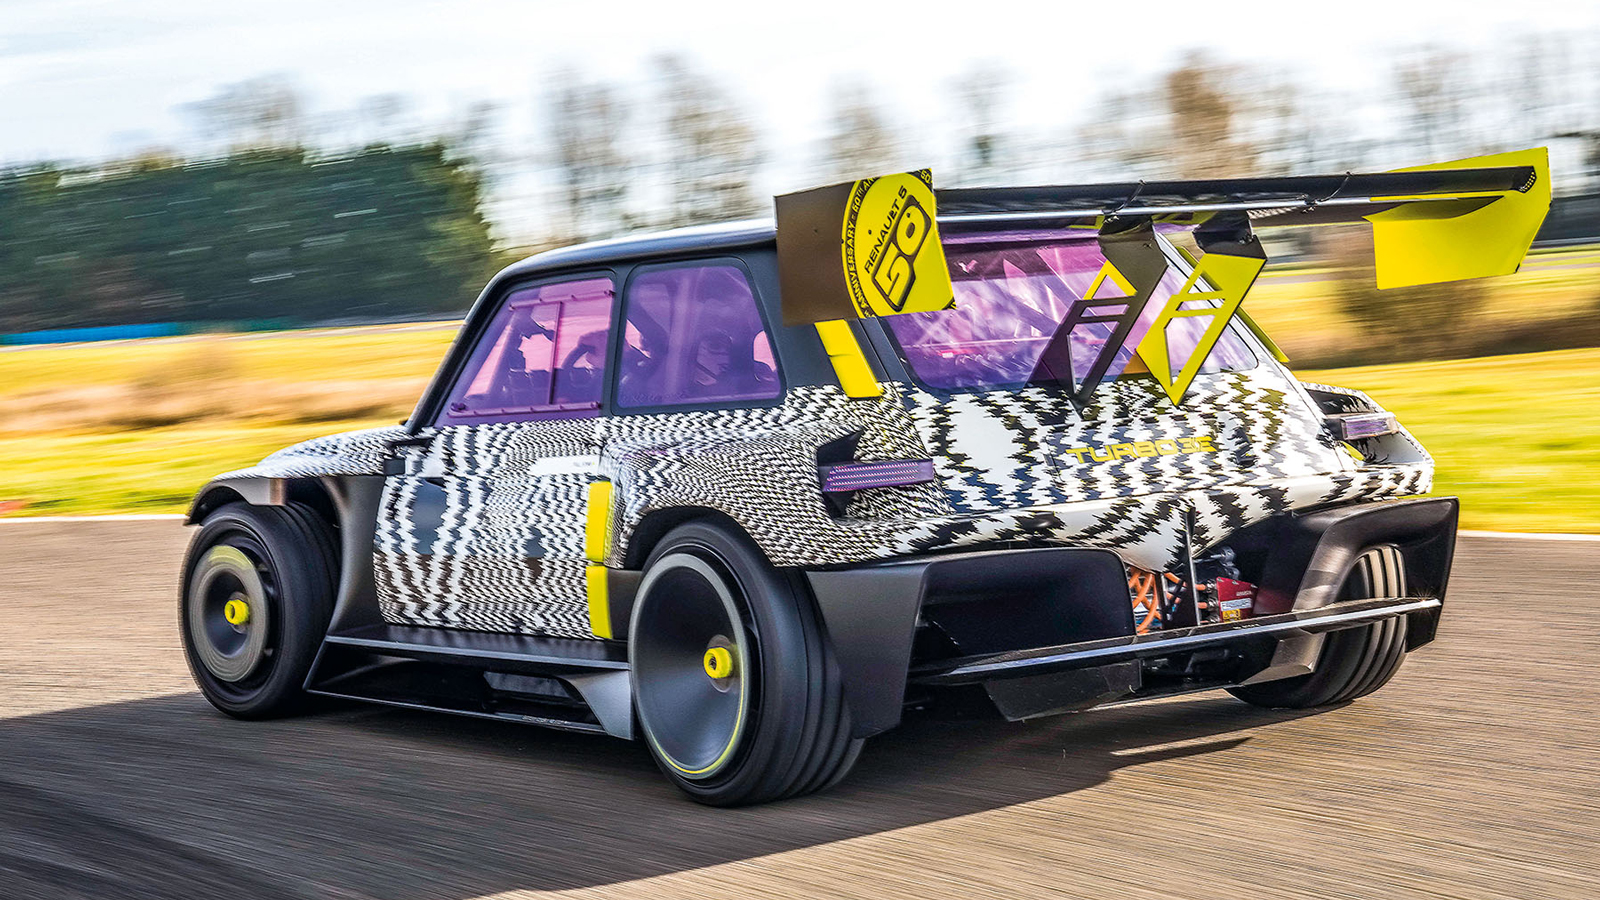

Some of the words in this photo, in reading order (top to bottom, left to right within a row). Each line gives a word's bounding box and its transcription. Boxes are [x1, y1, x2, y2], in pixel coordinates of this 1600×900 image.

[846, 222, 868, 309] ANNIVERSARY
[864, 199, 900, 274] RENAULT
[898, 185, 908, 199] 5
[872, 197, 929, 312] 50
